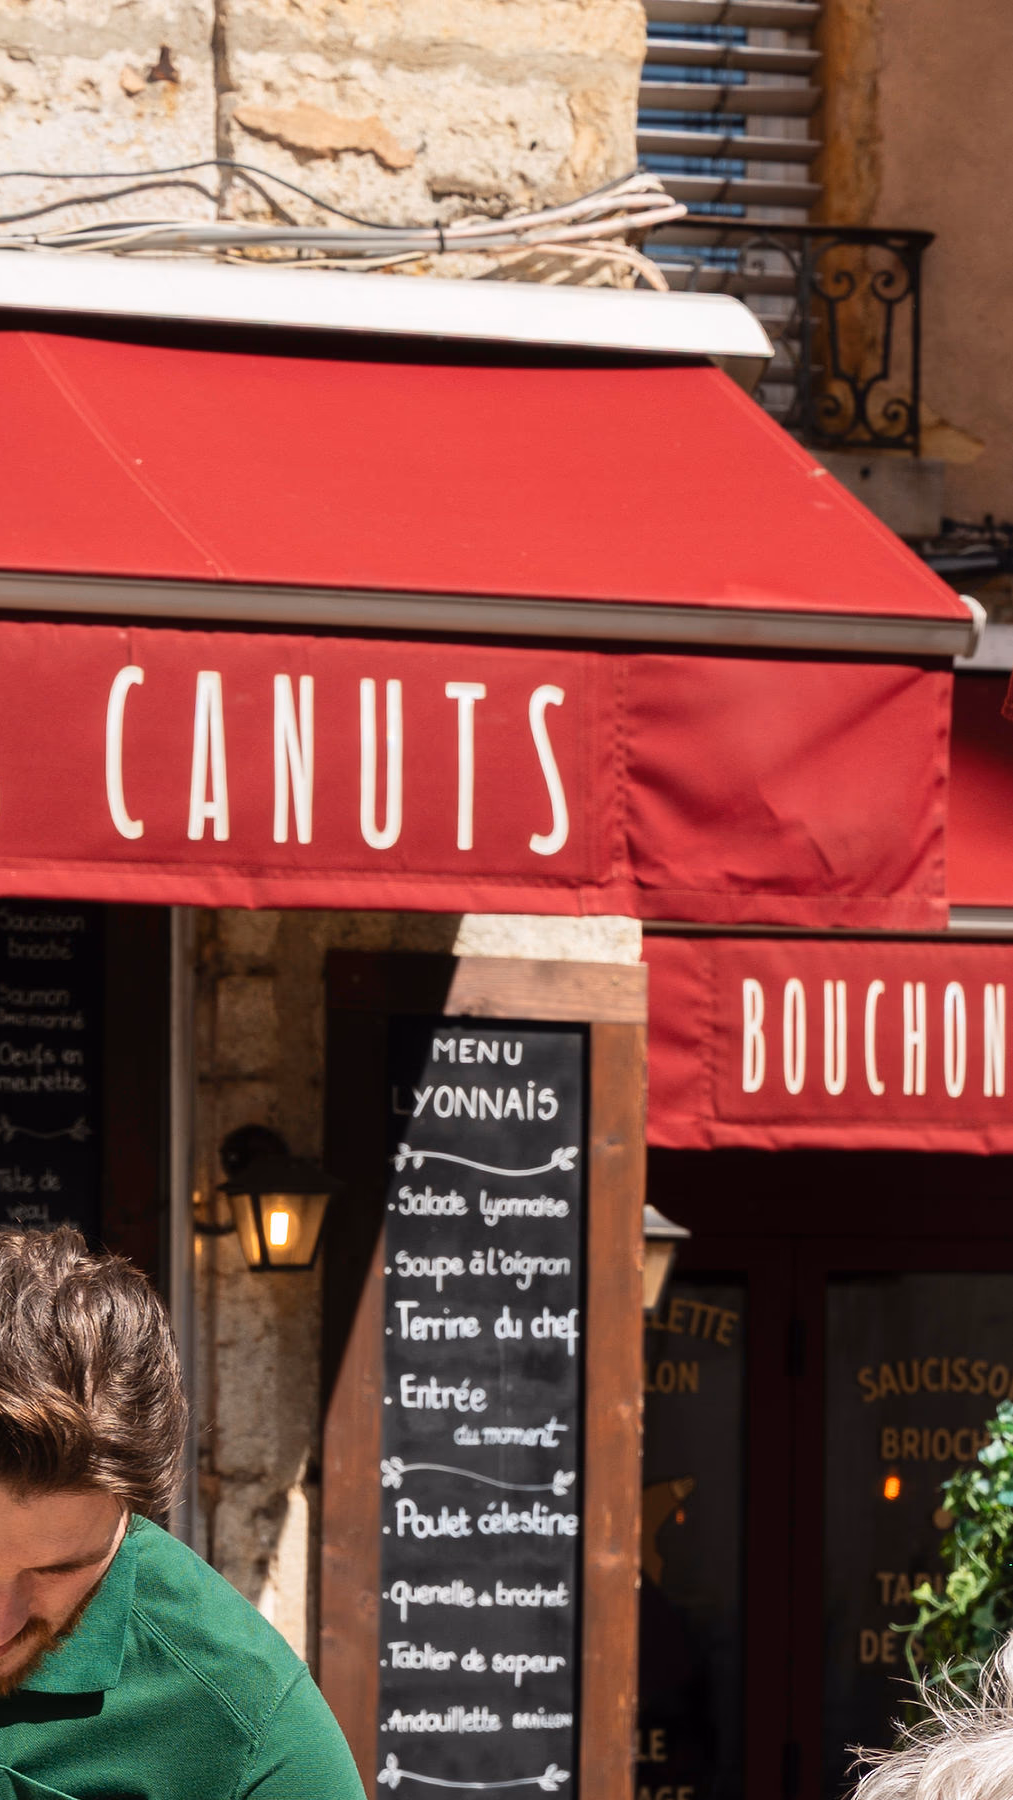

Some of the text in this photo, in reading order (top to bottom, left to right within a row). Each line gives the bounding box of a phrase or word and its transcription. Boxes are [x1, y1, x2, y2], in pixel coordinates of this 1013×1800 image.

[105, 664, 568, 856] CANUTS
[432, 1038, 523, 1065] MENU
[742, 977, 1006, 1098] BOUCHON
[398, 1185, 570, 1227] Salade lyonnaise
[395, 1250, 466, 1292] Soupe
[487, 1247, 571, 1291] l'oignon
[399, 1374, 487, 1412] Entrée
[856, 1356, 1013, 1404] SAUCISSO
[454, 1417, 568, 1447] du moment
[881, 1425, 992, 1461] BRIOCH
[396, 1498, 580, 1538] Poulet célestine
[495, 1580, 570, 1607] brochet
[388, 1641, 566, 1687] Tablier de sapeur
[859, 1627, 898, 1664] DE
[388, 1705, 502, 1733] Andouillette
